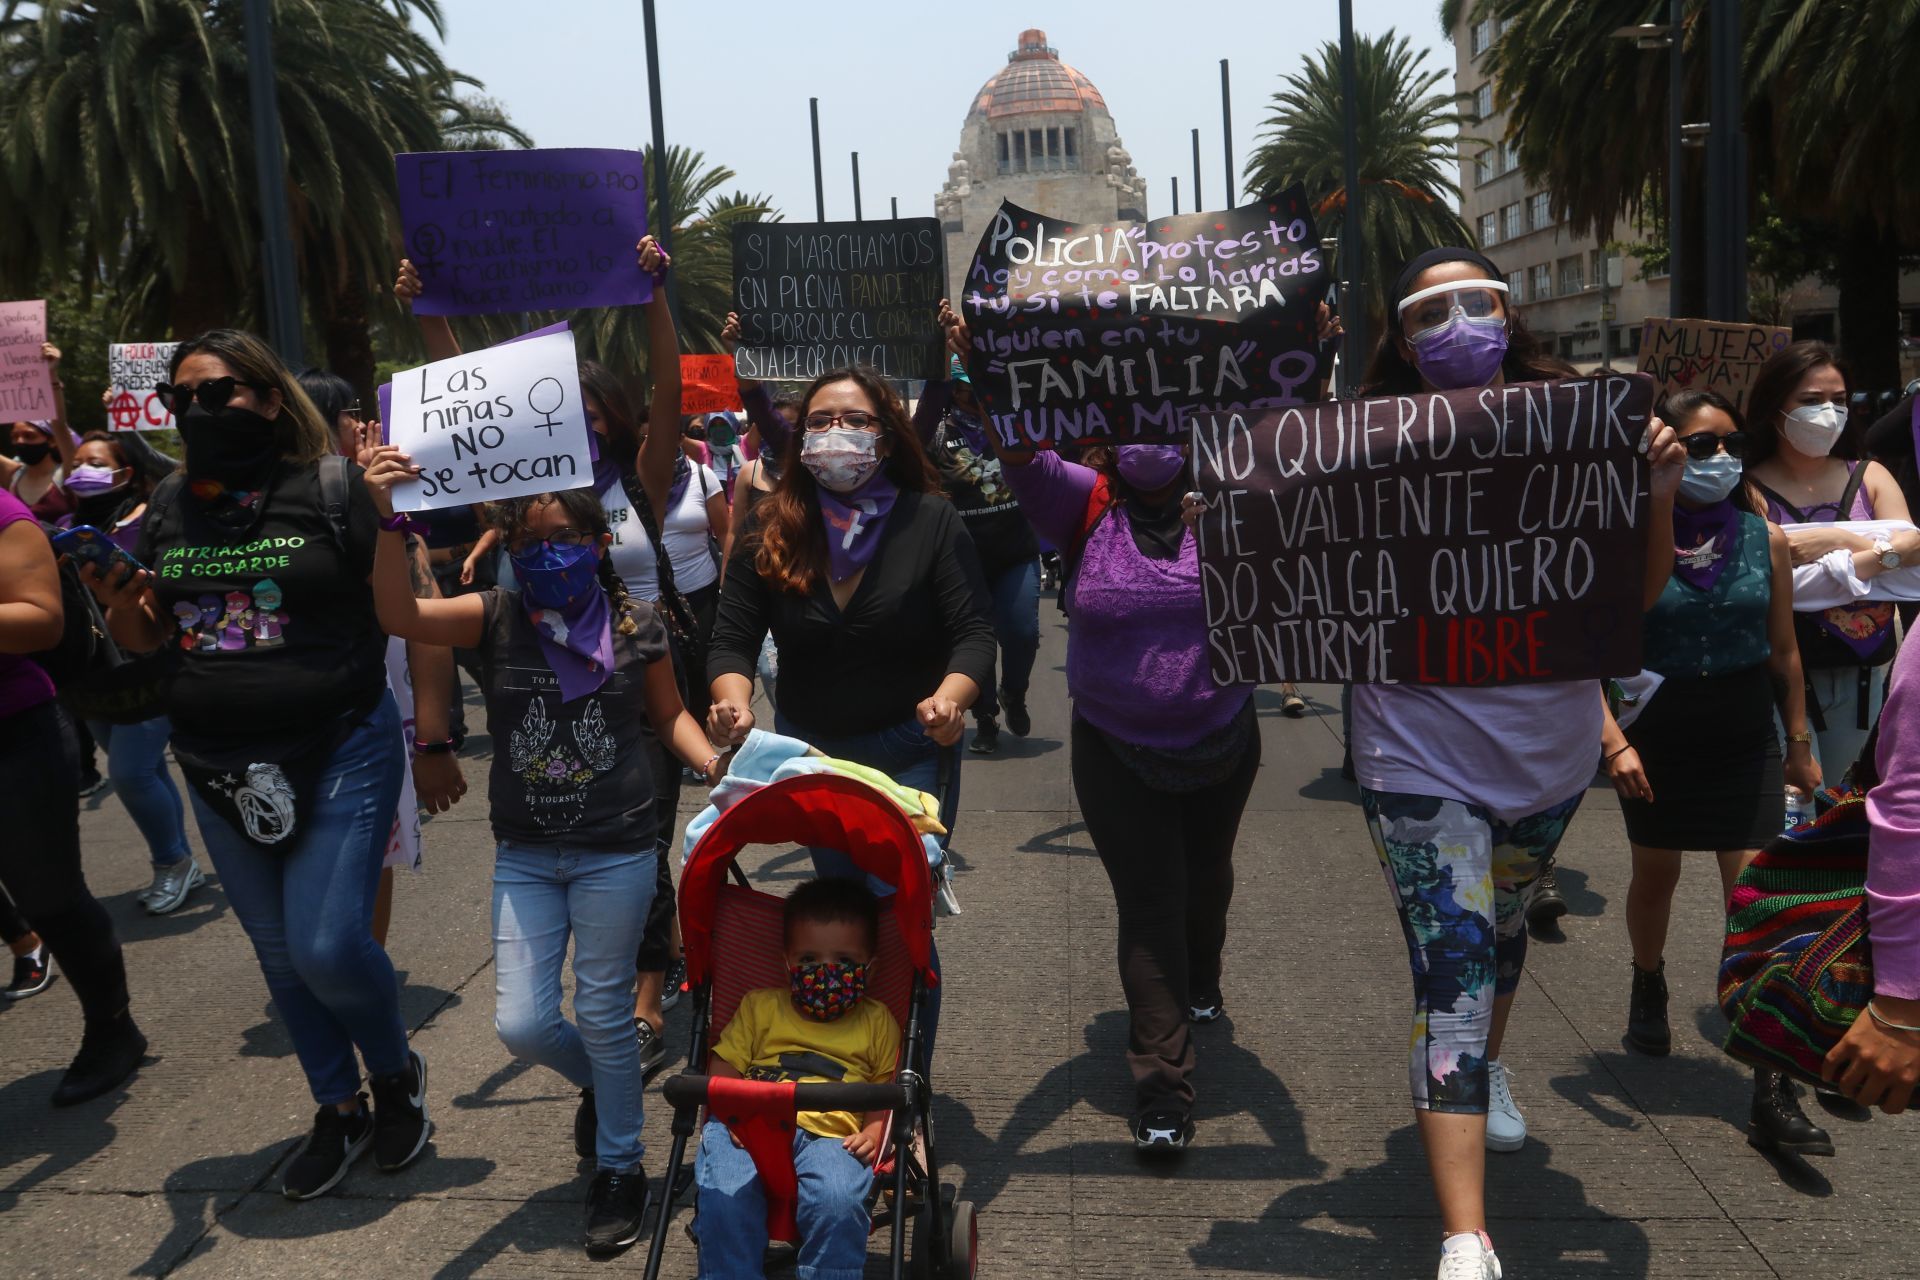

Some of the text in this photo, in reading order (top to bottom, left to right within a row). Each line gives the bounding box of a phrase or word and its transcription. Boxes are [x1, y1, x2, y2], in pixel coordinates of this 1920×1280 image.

[418, 159, 452, 198] El
[606, 170, 639, 191] no
[592, 207, 615, 226] a
[533, 227, 559, 254] El
[745, 229, 935, 272] SI MARCHAMOS
[589, 250, 614, 273] lo
[1042, 266, 1140, 286] como
[449, 285, 512, 306] hace
[739, 276, 768, 309] EN
[779, 274, 844, 309] PLENA
[1079, 285, 1120, 311] te
[1128, 278, 1288, 316] FALTARA
[771, 311, 845, 343] PORQUE
[850, 312, 873, 339] EL
[1101, 327, 1145, 347] en
[1157, 318, 1200, 345] tu
[1656, 325, 1767, 361] MUJER
[111, 346, 123, 359] LA
[735, 346, 779, 377] ESTA
[783, 344, 825, 378] PEOR
[871, 344, 892, 377] EL
[420, 366, 487, 405] Las
[423, 395, 514, 433] niñas
[1024, 402, 1112, 443] UNA
[1192, 413, 1256, 482] NO
[1275, 394, 1457, 478] QUIERO
[1471, 376, 1646, 461] SENTIR-
[451, 425, 505, 461] NO
[468, 454, 576, 489] tocan
[1198, 457, 1648, 557] ME VALIENTE CUAN-
[163, 536, 305, 560] PATRIARCADO
[162, 555, 291, 578] ES COBARDE
[1201, 536, 1595, 628] DO SALGA, QUIERO
[1208, 611, 1553, 686] SENTIRME LIBRE
[532, 676, 545, 684] TO
[540, 792, 588, 803] YOURSELF
